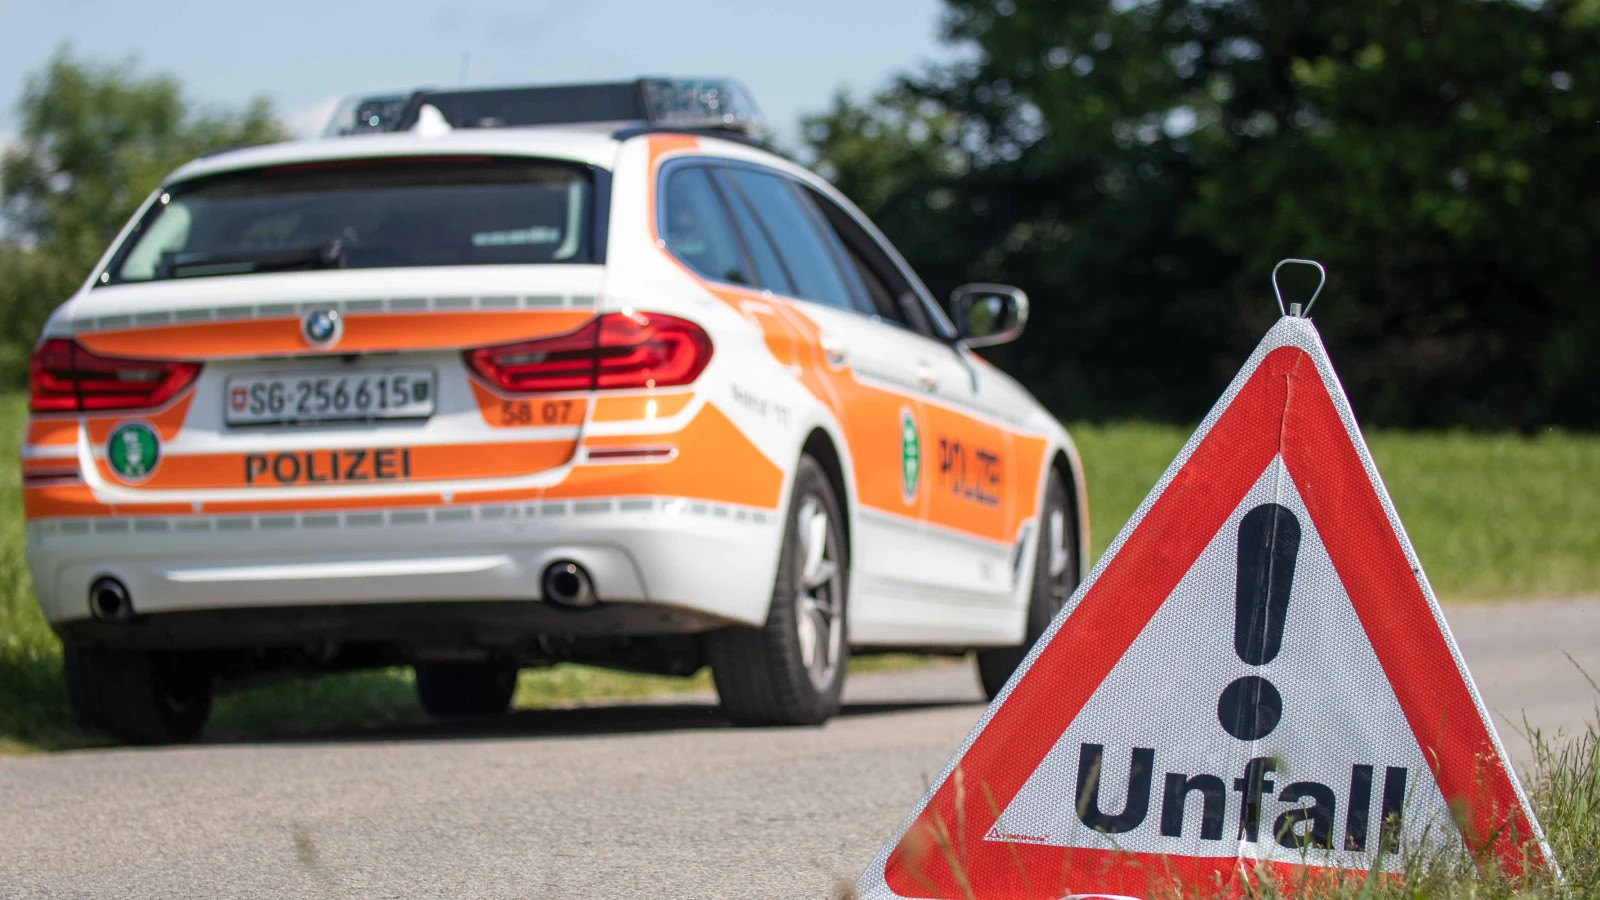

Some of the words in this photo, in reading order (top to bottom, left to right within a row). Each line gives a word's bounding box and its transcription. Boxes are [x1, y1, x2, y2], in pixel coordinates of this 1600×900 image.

[502, 400, 532, 425] 58
[542, 401, 572, 424] 07
[245, 447, 411, 487] POLIZEI
[1074, 742, 1408, 855] Unfall
